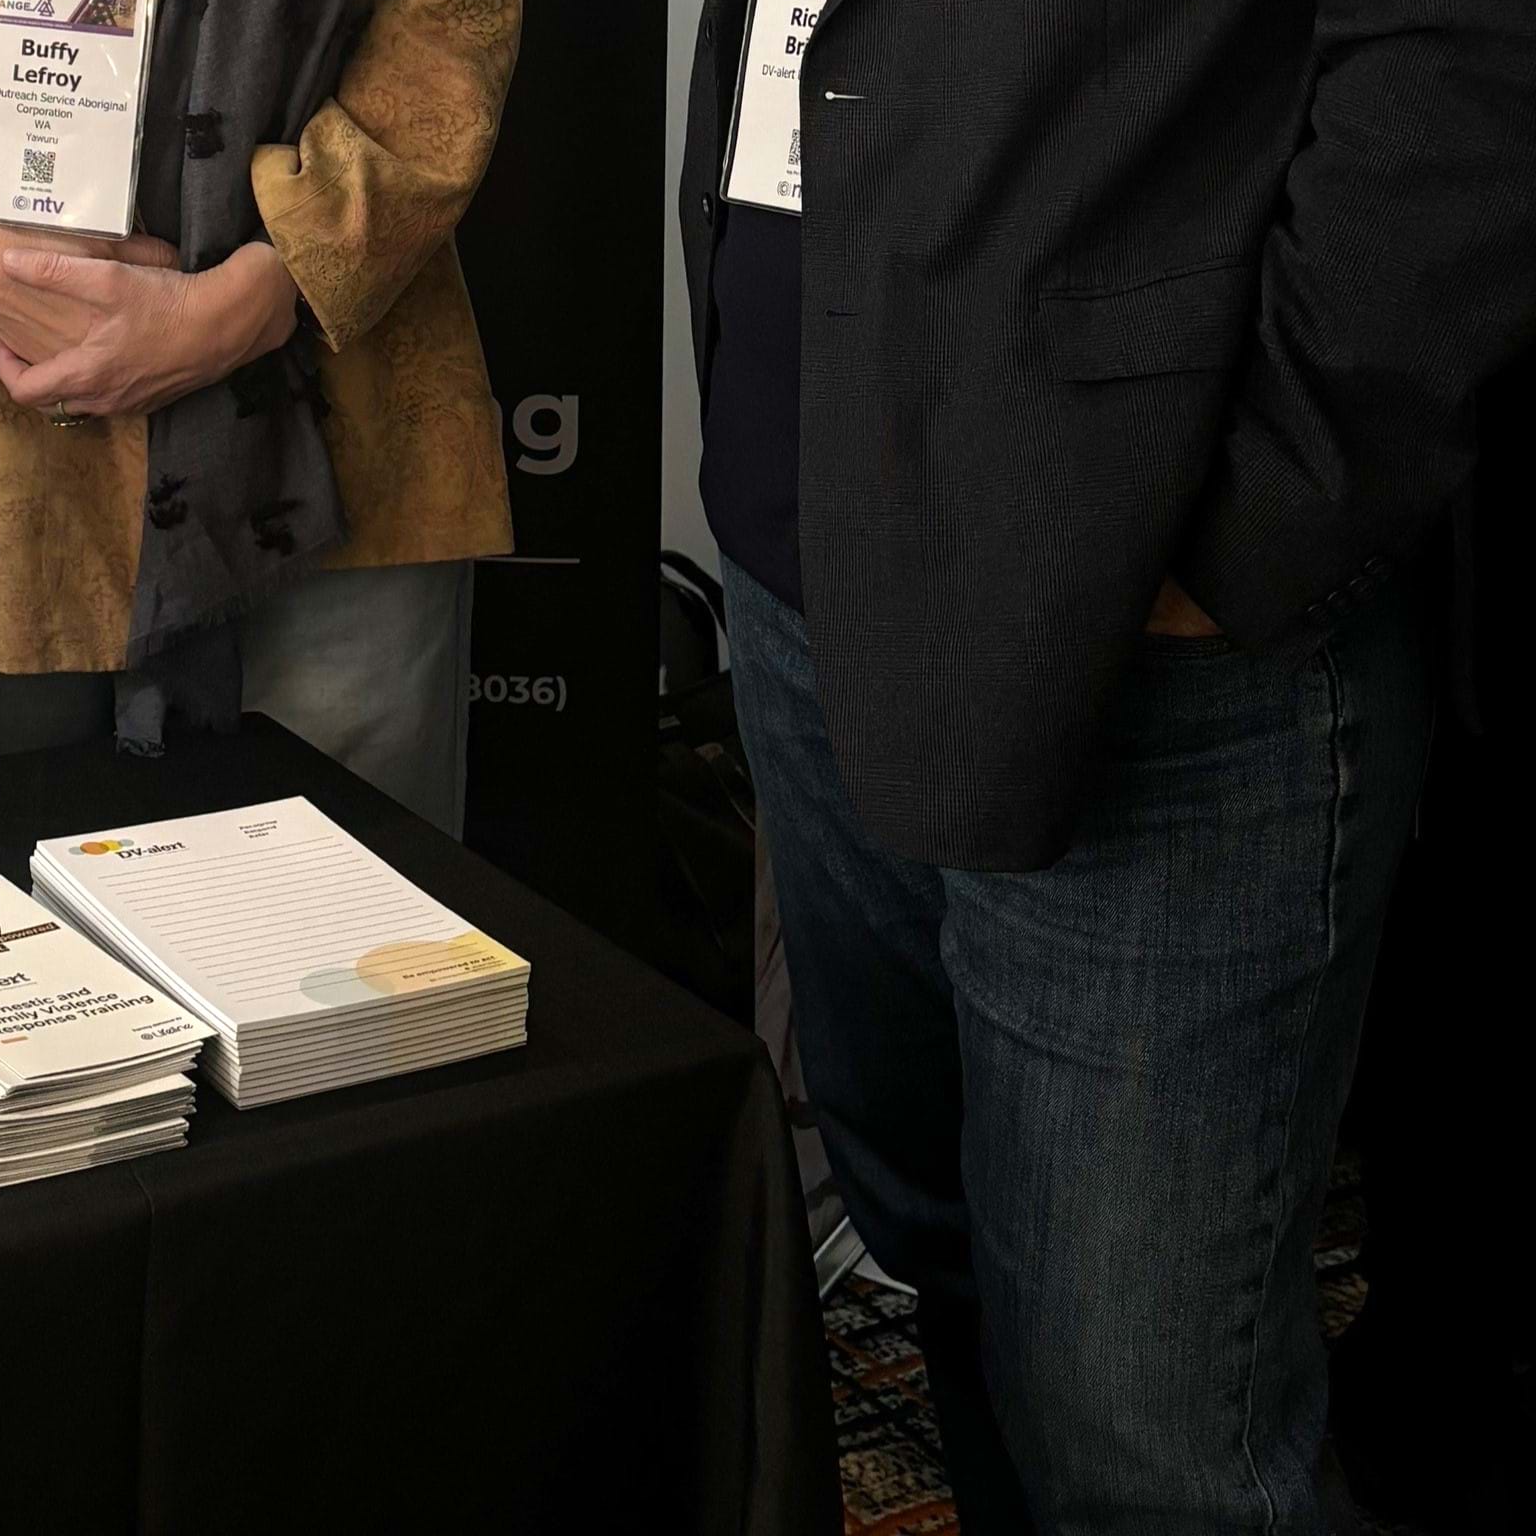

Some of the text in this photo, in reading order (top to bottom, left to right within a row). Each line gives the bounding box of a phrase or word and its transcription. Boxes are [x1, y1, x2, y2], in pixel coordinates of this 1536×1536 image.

[790, 7, 820, 29] Ric
[20, 37, 80, 66] Buffy
[12, 64, 83, 93] Lefroy
[761, 64, 796, 81] DV-alert
[16, 103, 73, 120] Corporation
[40, 92, 76, 107] Service
[78, 97, 128, 113] Aboriginal
[34, 119, 52, 131] WA
[25, 132, 59, 146] Yawuru
[32, 196, 65, 214] ntv
[115, 840, 187, 860] DV-alert
[39, 991, 120, 1016] Violence
[57, 986, 93, 1002] and
[78, 994, 156, 1020] Training
